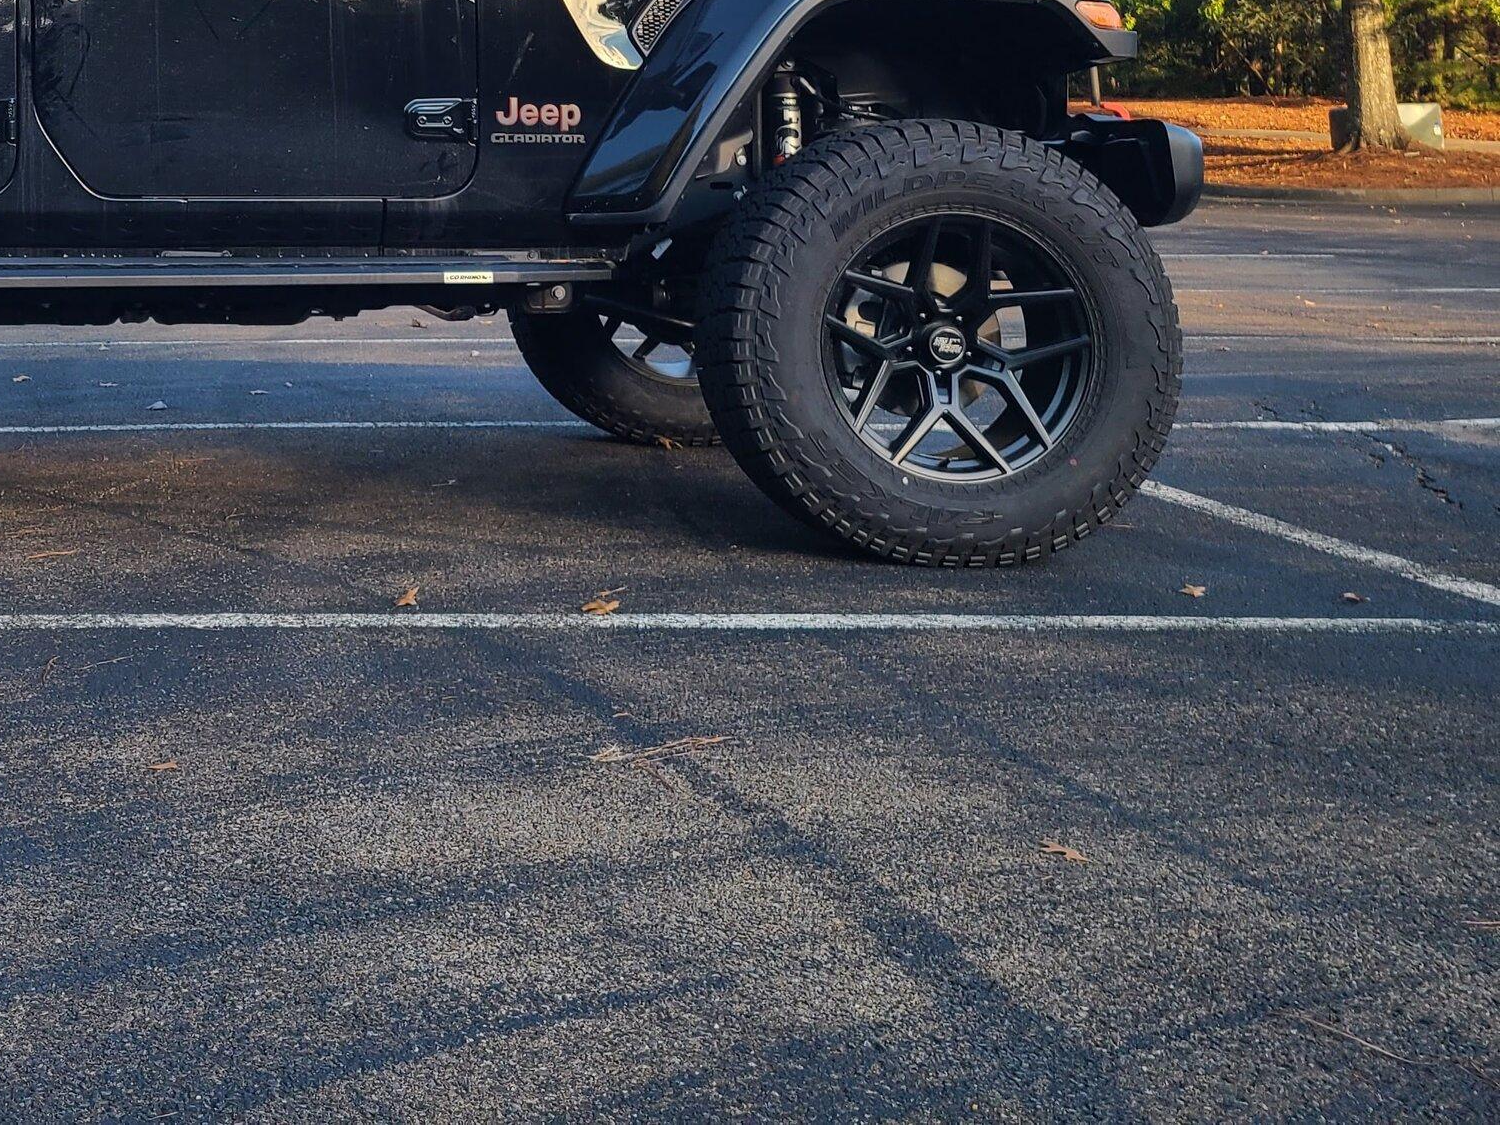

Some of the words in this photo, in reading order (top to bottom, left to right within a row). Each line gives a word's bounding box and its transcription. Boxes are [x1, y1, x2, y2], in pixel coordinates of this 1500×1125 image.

[495, 96, 581, 132] Jeep
[490, 132, 586, 144] GLADIATOR
[828, 171, 1060, 242] WILDPEAK
